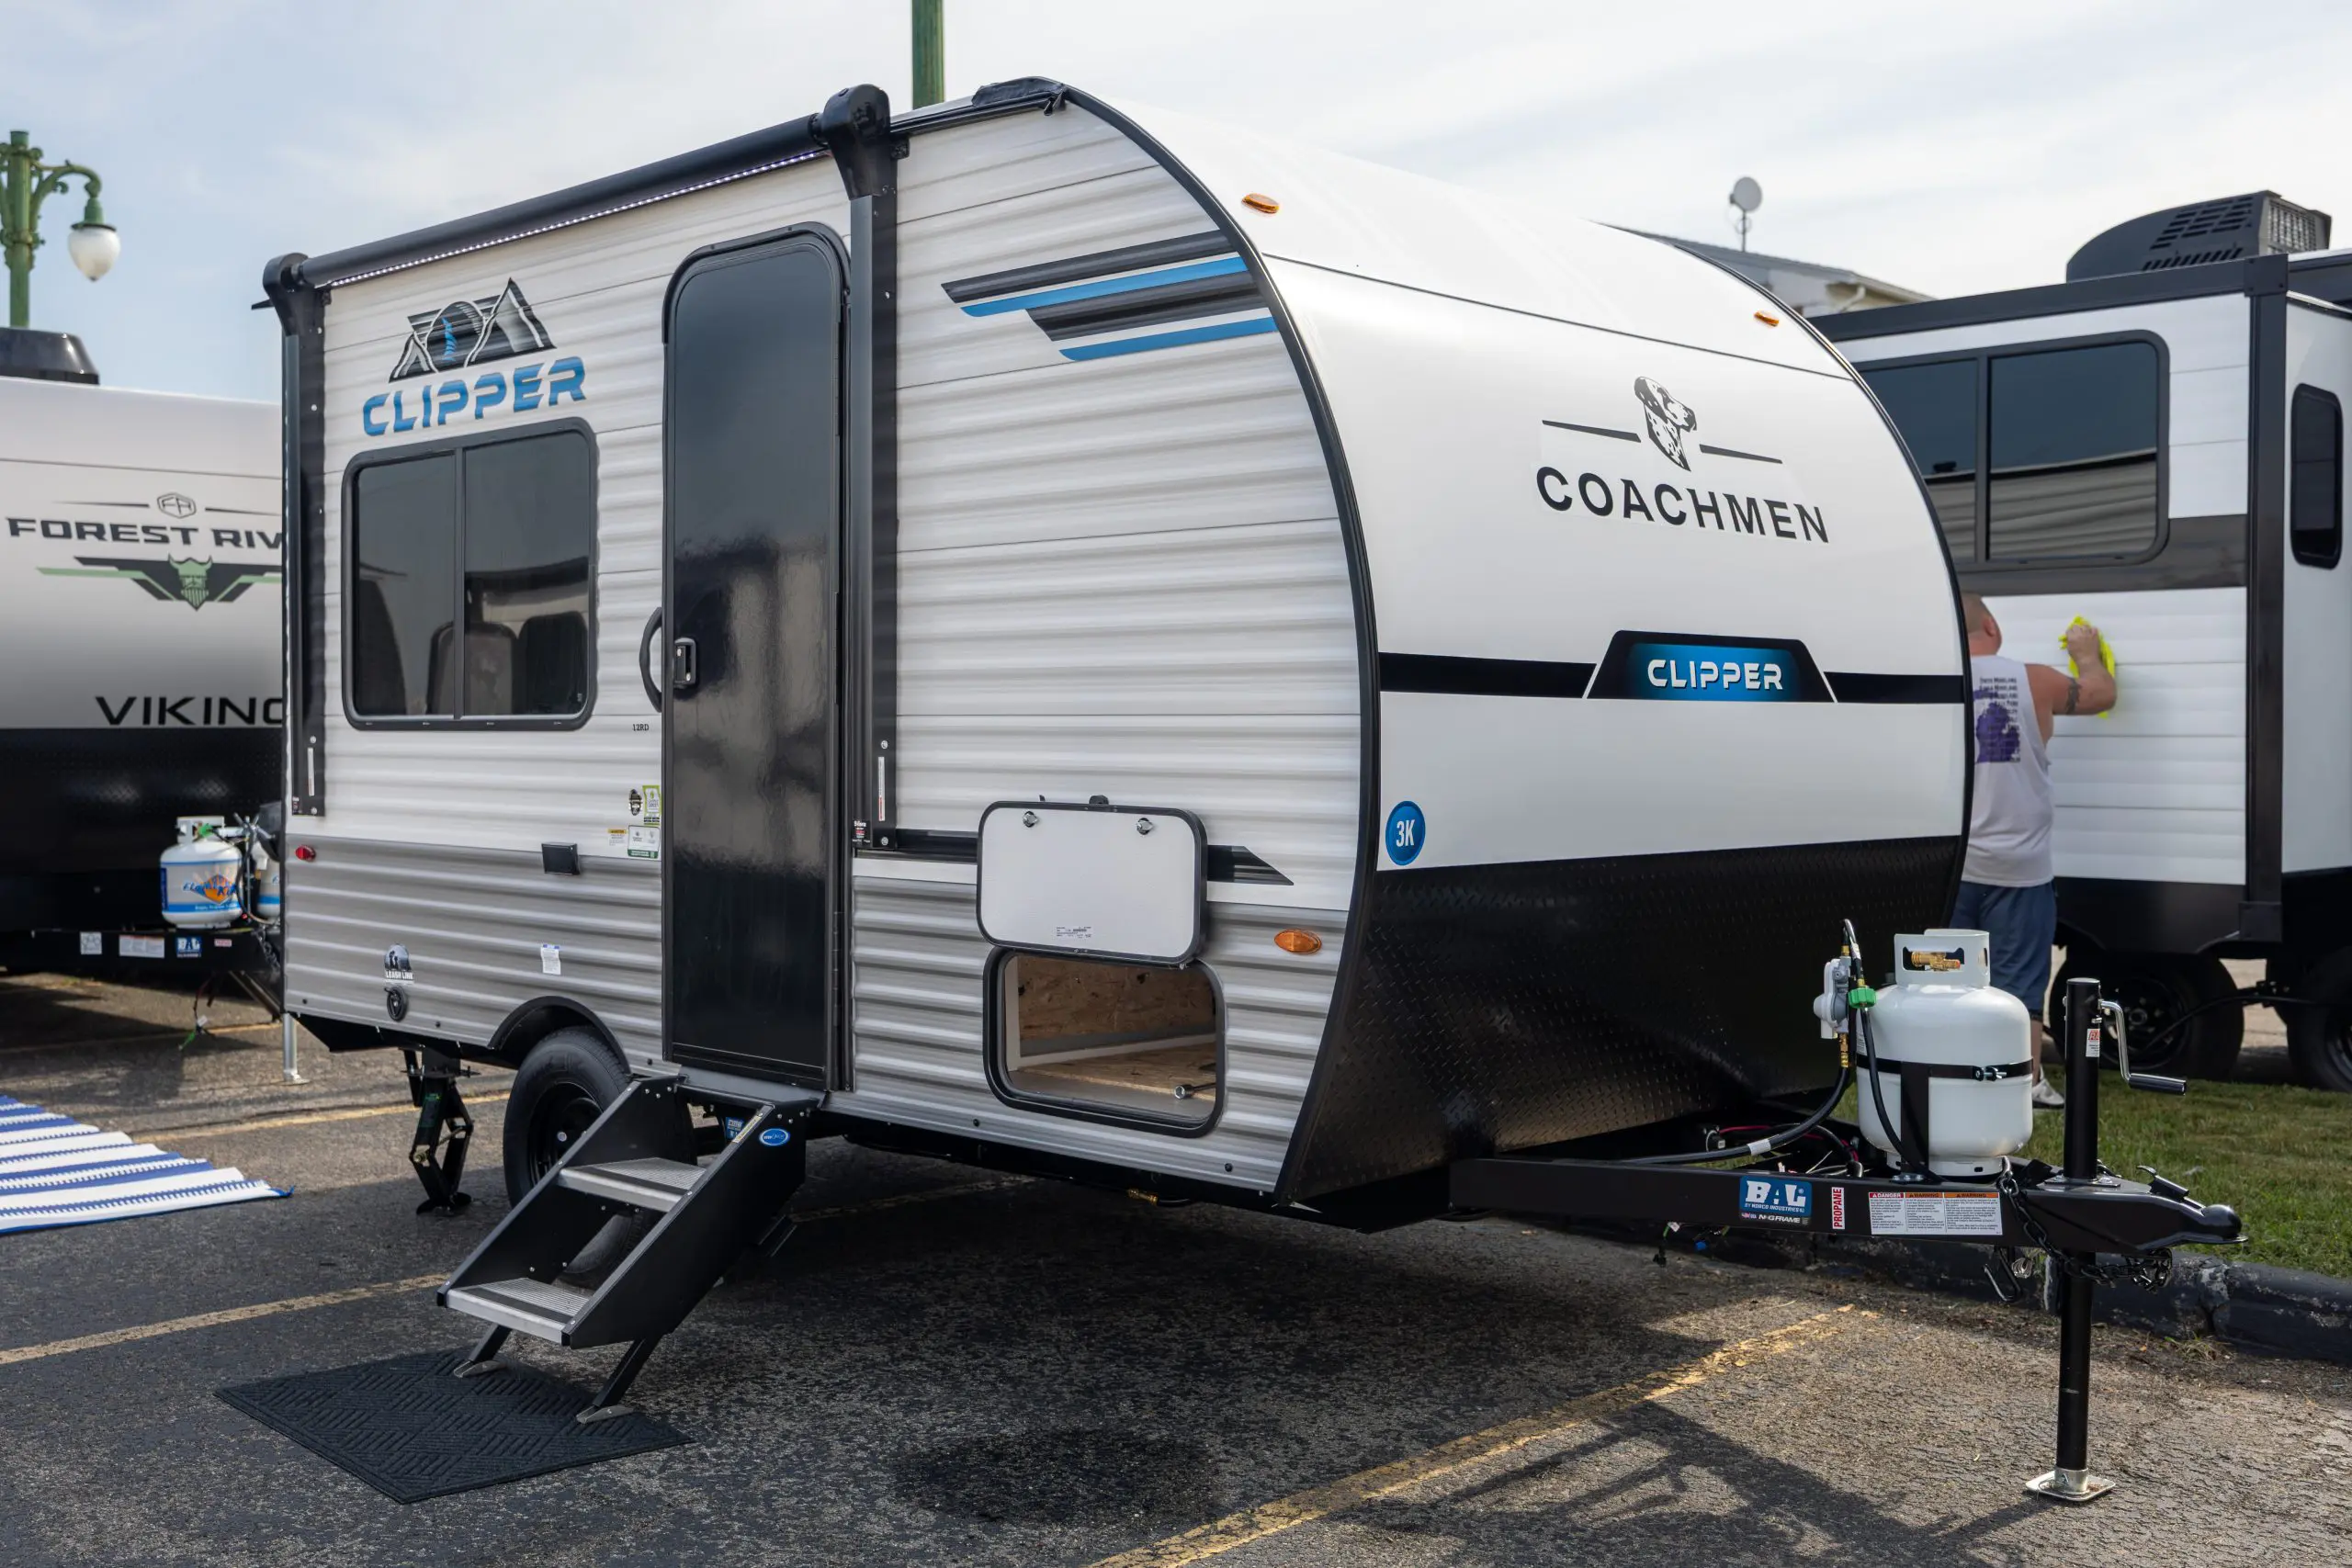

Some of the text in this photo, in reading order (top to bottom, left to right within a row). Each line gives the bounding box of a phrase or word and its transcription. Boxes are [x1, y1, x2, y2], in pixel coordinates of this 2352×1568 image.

[362, 356, 586, 436] CLIPPER
[1536, 466, 1829, 543] COACHMEN
[6, 517, 198, 546] FOREST
[1647, 659, 1783, 690] CLIPPER
[1396, 819, 1415, 847] 3K
[1746, 1180, 1806, 1207] BAL
[1833, 1188, 1842, 1228] PROPANE
[1775, 1215, 1800, 1224] FRAME
